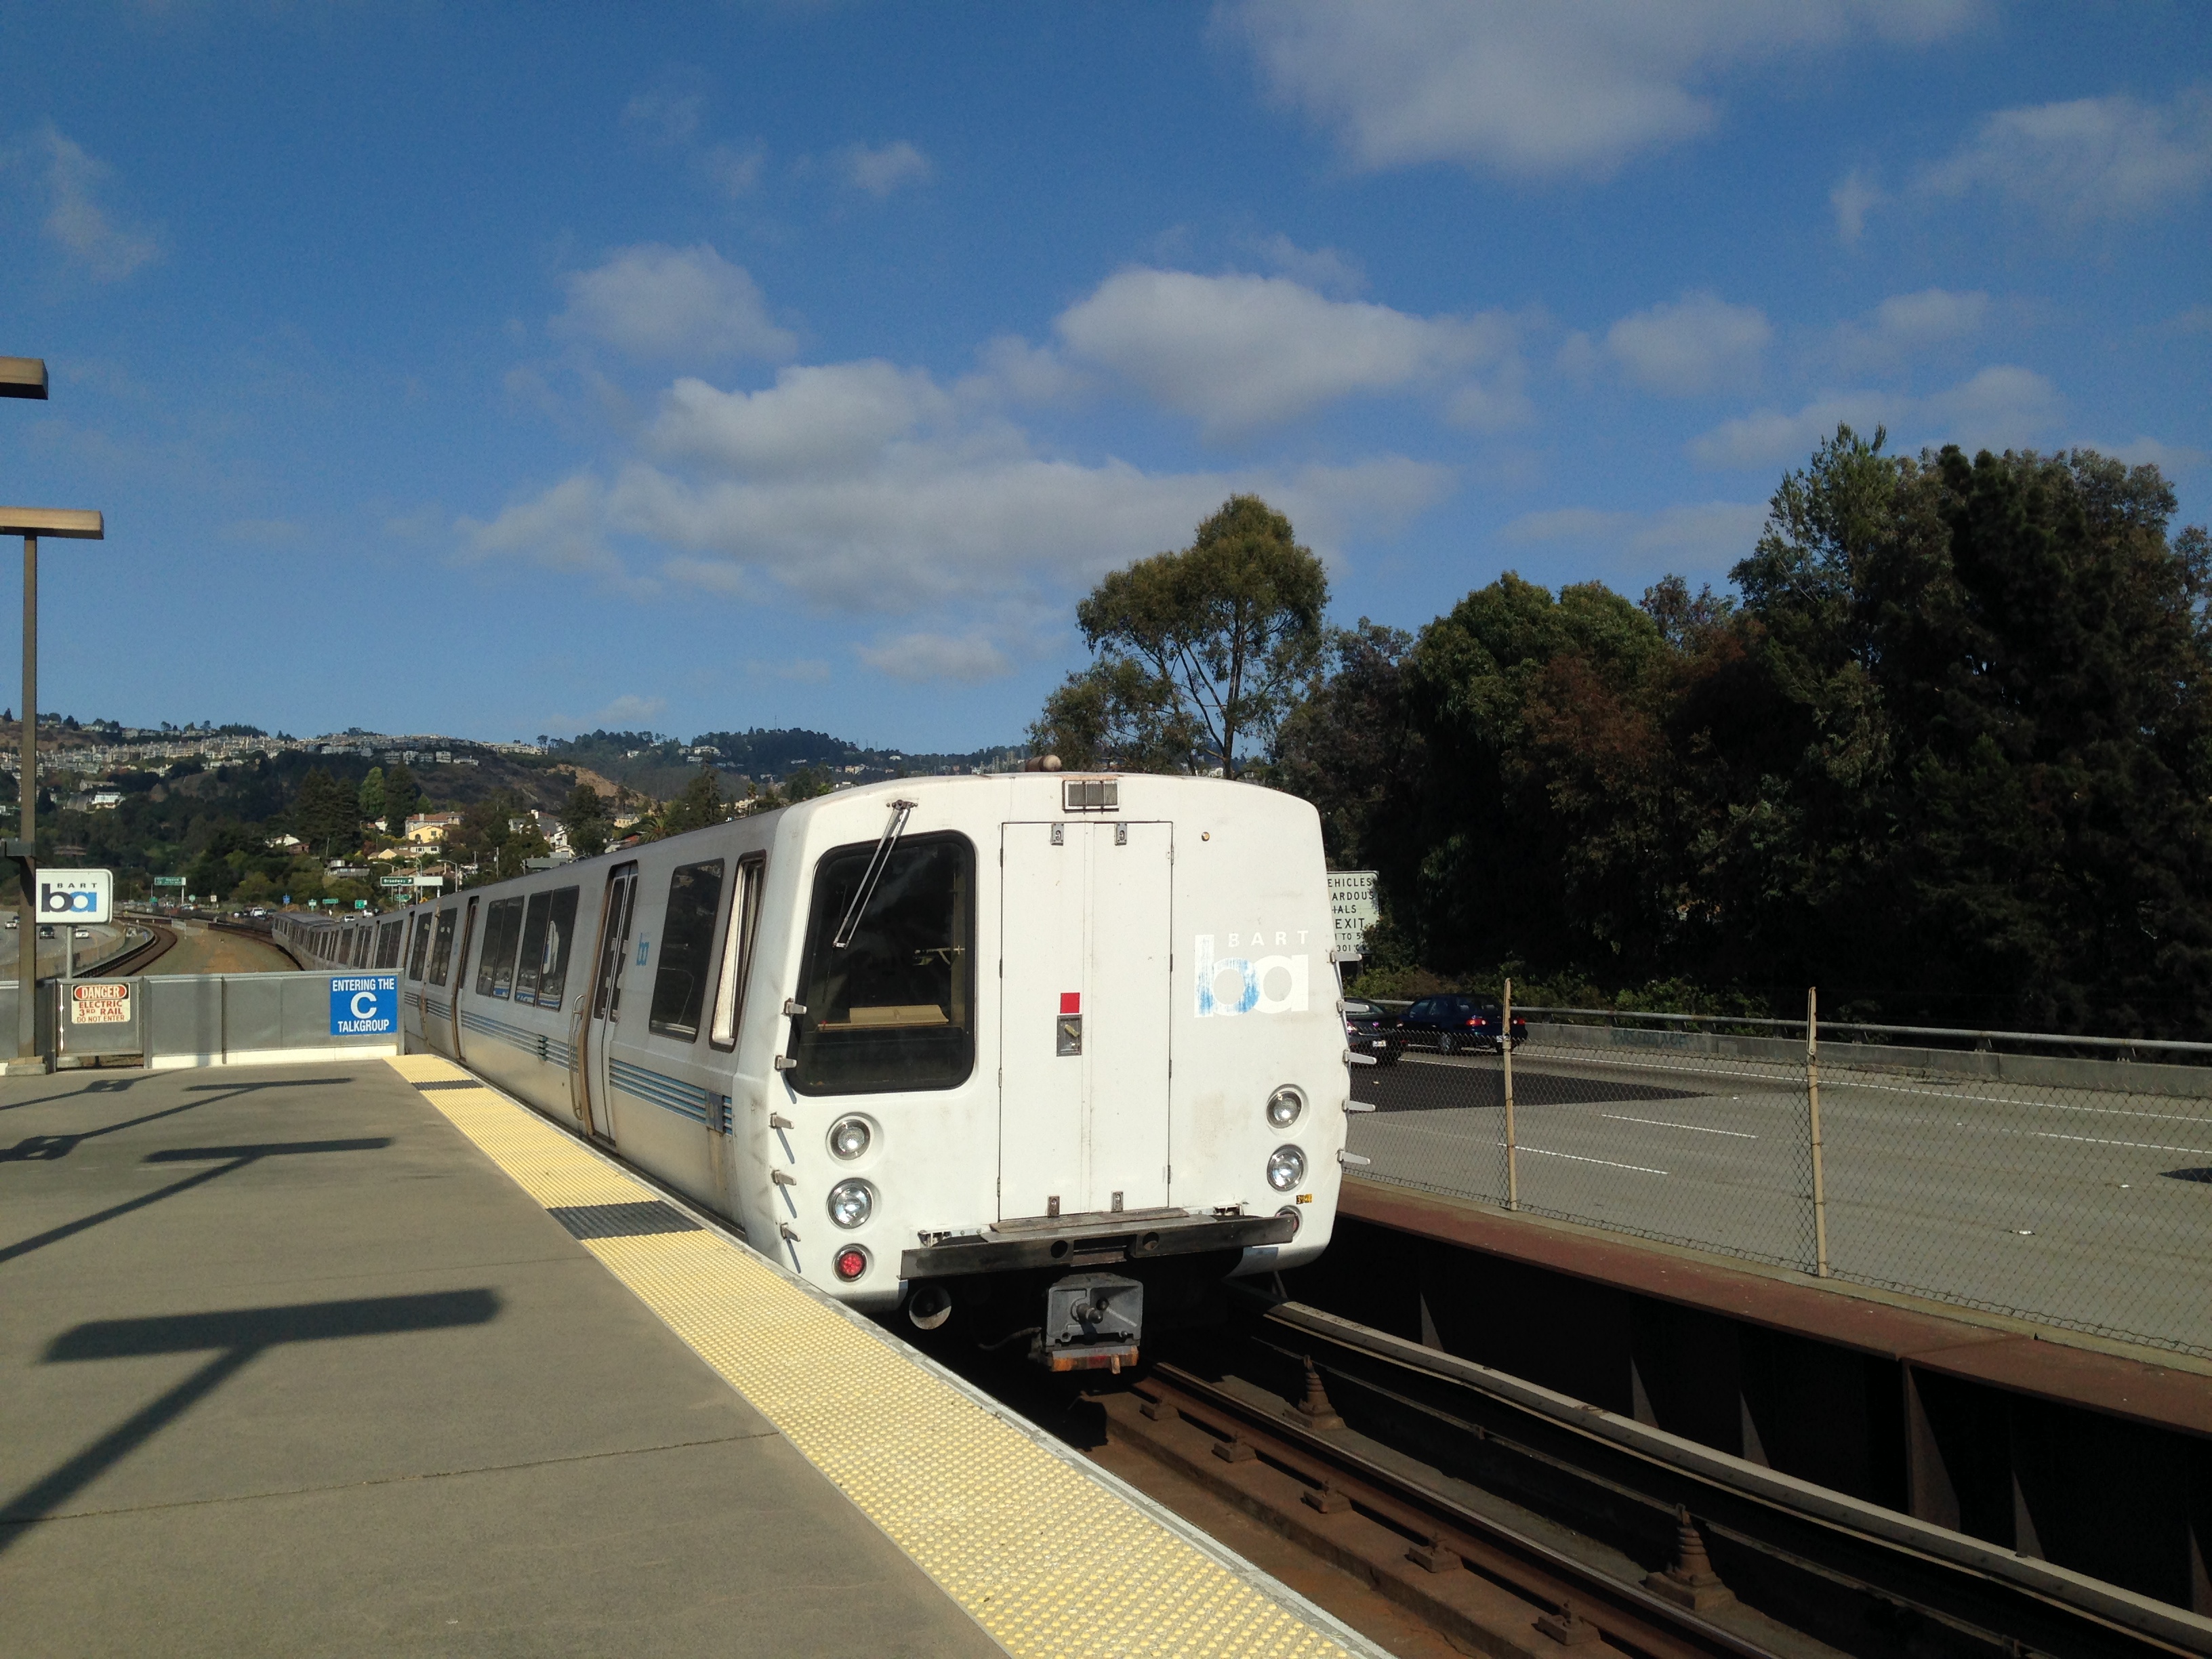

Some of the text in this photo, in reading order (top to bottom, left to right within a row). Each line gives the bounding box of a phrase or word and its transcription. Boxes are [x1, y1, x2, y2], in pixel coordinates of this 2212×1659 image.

[41, 883, 98, 913] ba
[1335, 918, 1365, 929] EXIT
[1228, 930, 1309, 947] BART
[1193, 934, 1309, 1019] ba
[333, 978, 394, 991] ENTERING THE
[81, 986, 120, 999] DANGER
[79, 1000, 123, 1008] ELECTRIC
[350, 991, 377, 1019] C
[79, 1008, 96, 1017] 3RD
[337, 1019, 390, 1033] TALKGROUP
